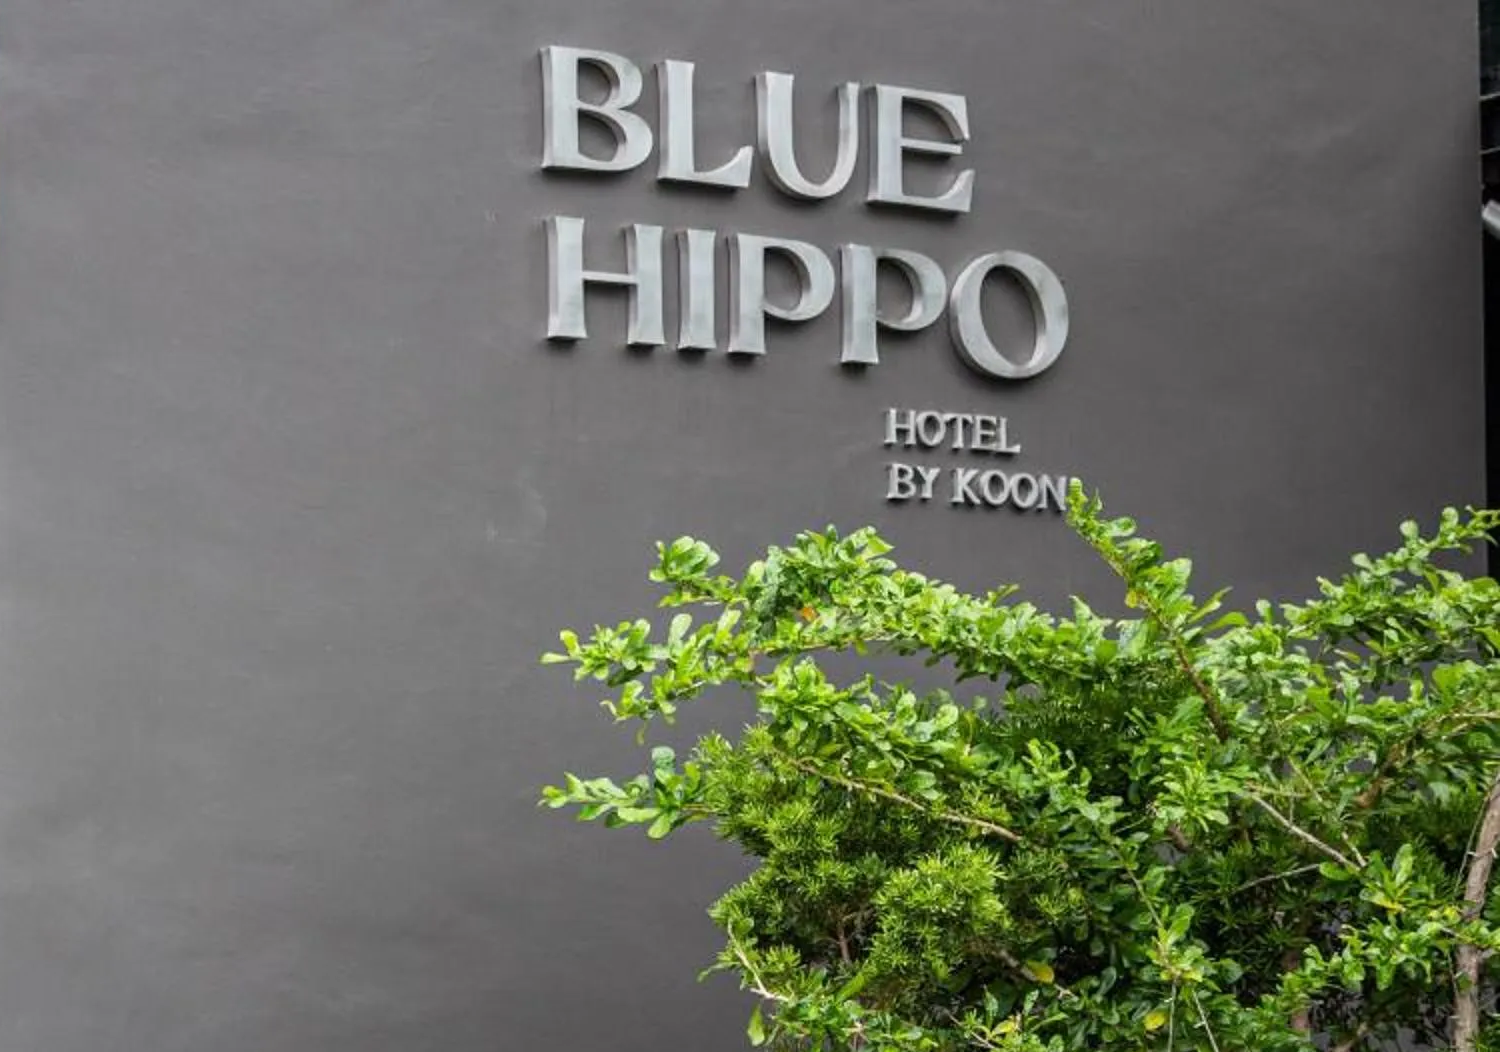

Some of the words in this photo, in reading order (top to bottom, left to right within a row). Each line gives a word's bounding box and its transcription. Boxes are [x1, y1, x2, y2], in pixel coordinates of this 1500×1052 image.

[539, 45, 975, 213] BLUE
[544, 215, 1069, 380] HIPPO
[883, 407, 1021, 454] HOTEL
[885, 462, 941, 500] BY
[951, 466, 1067, 512] KOON
